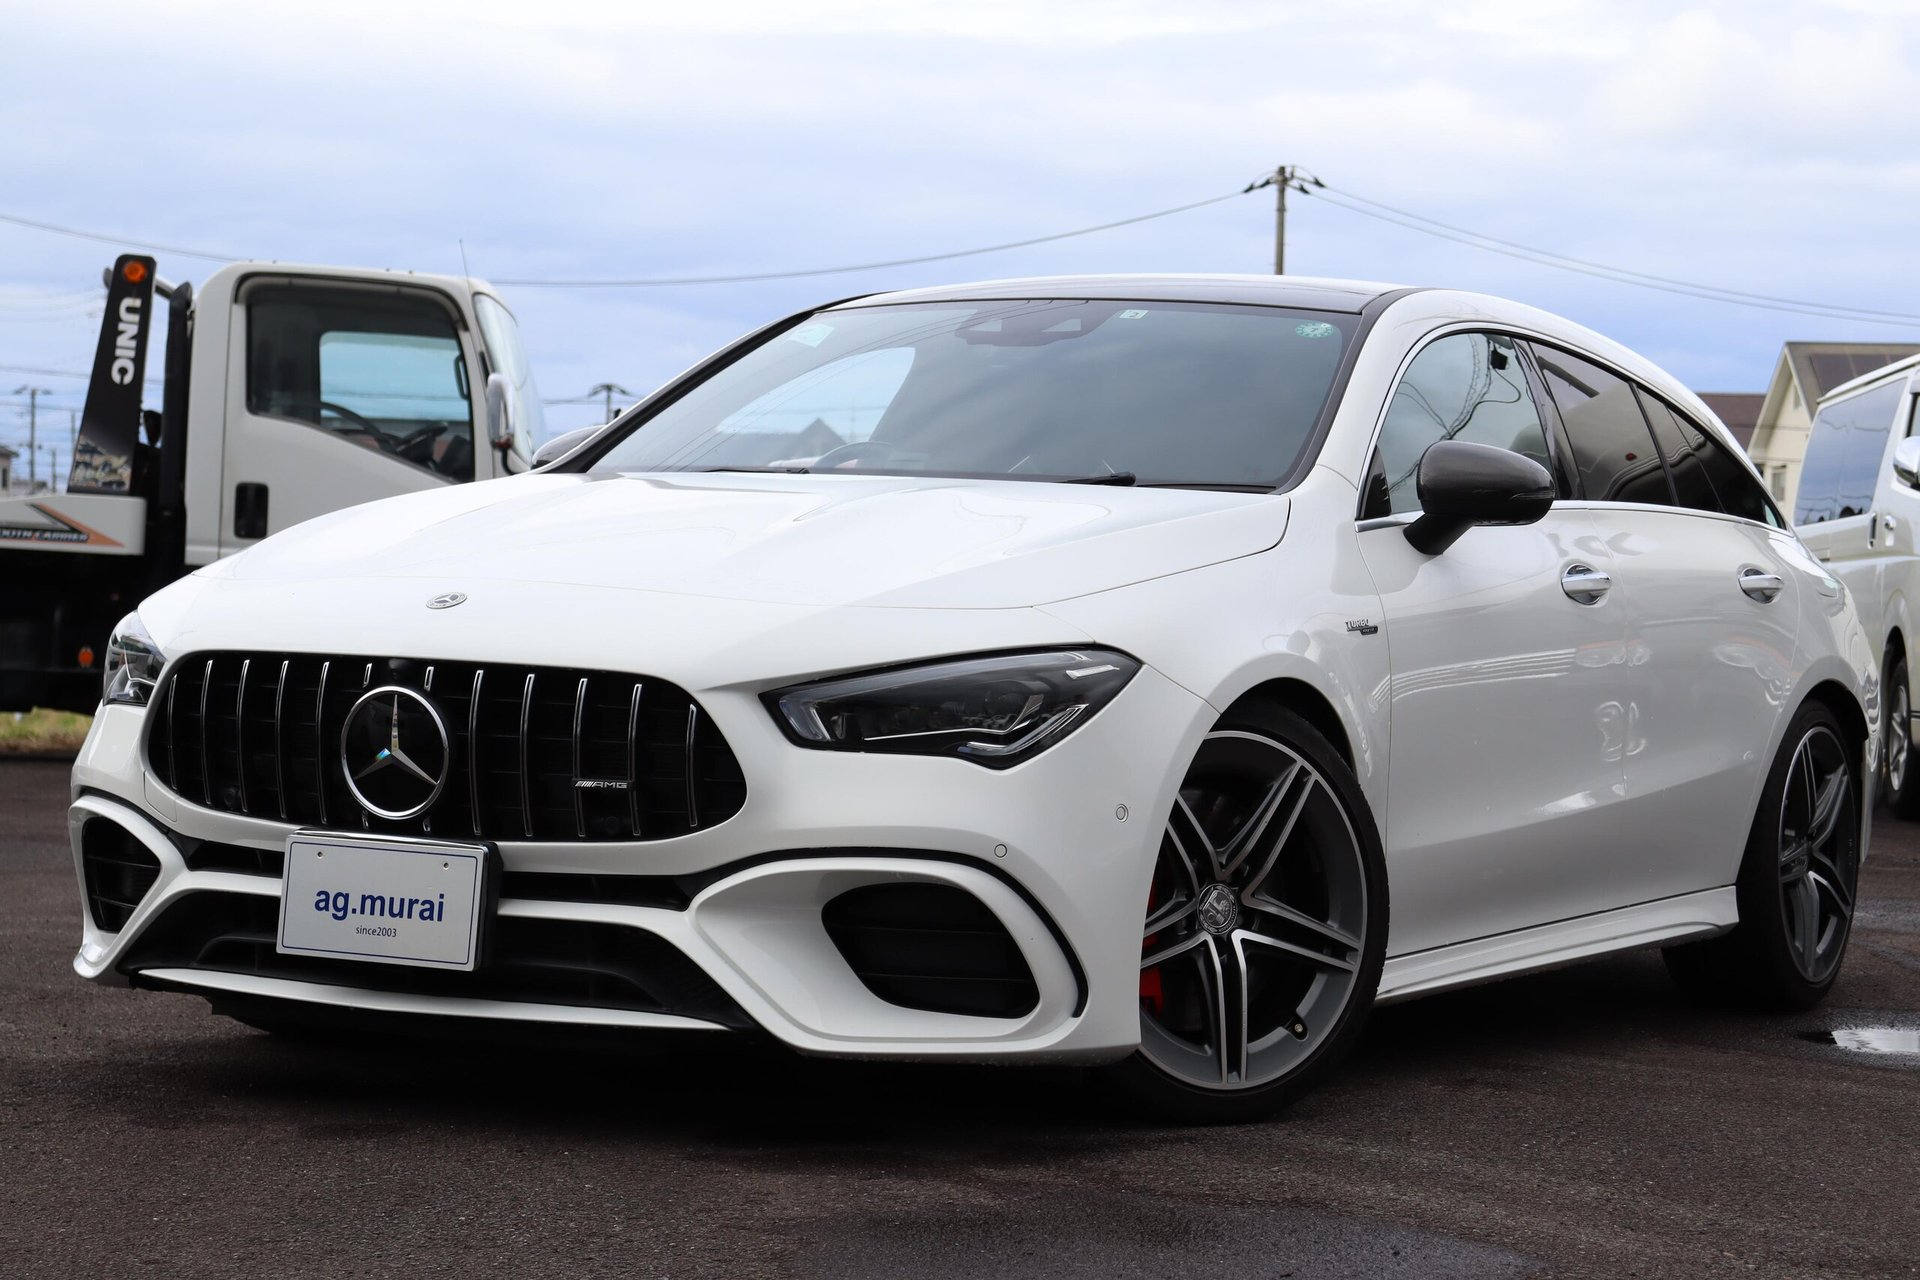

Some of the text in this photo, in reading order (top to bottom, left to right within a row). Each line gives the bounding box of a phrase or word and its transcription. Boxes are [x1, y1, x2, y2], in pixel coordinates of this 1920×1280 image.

[111, 297, 142, 385] UNIC
[591, 781, 628, 789] AMG
[314, 890, 445, 922] ag.murai
[355, 925, 397, 938] since2003
